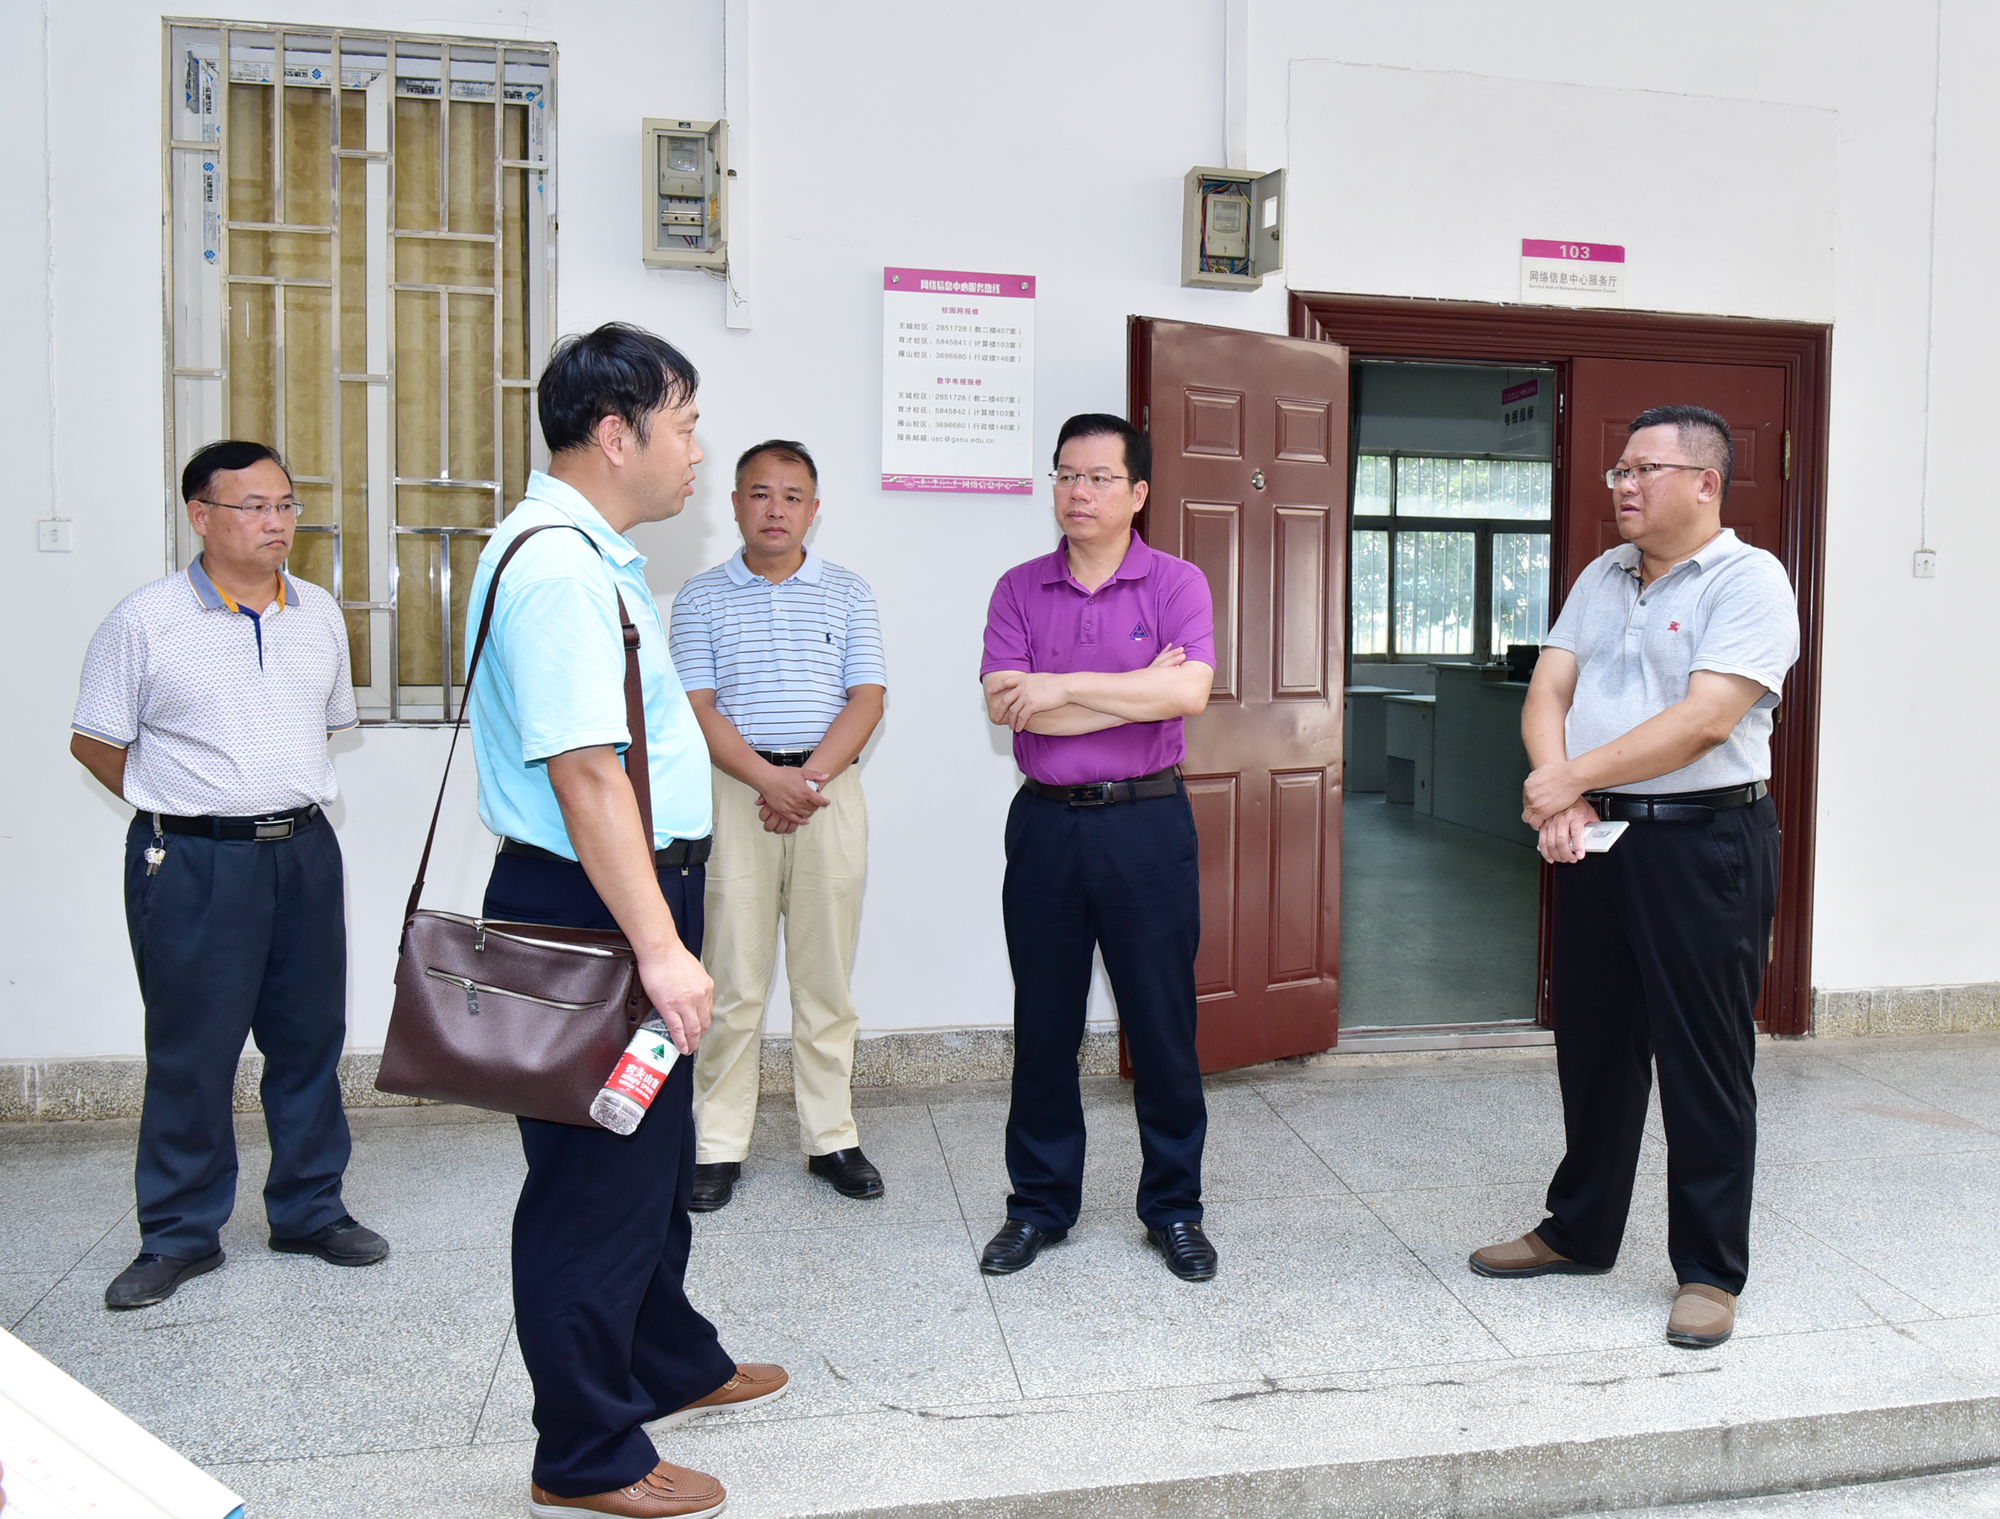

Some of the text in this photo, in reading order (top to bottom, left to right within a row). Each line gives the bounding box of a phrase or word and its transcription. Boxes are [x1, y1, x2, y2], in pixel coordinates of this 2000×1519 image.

[1559, 244, 1591, 259] 103
[920, 279, 1001, 294] 网络信息中心服务热线
[1529, 270, 1618, 288] 网络信息中心服务厅
[941, 306, 979, 316] 校园网报修
[936, 377, 982, 386] 数字电视报修
[624, 1063, 661, 1090] 农夫山泉
